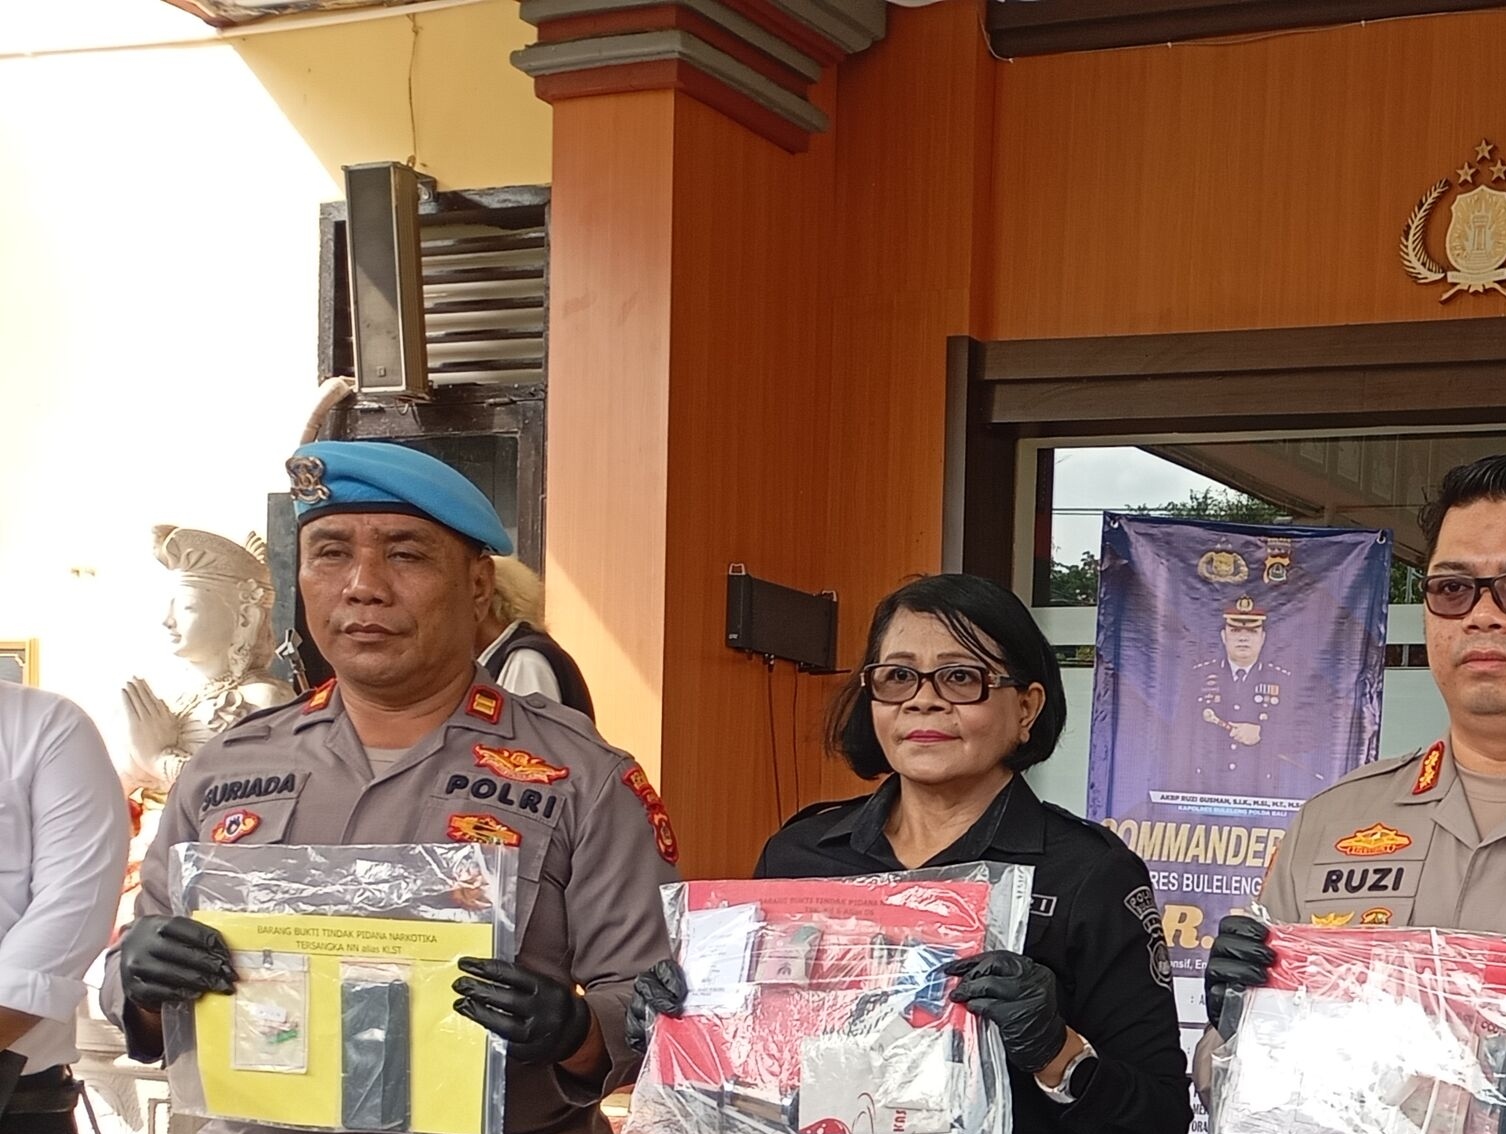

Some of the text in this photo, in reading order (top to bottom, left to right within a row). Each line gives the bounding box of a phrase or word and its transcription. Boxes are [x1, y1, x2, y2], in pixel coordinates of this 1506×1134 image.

[202, 773, 296, 811] SURIADA
[445, 774, 557, 819] POLRI
[1183, 874, 1263, 895] BULELENG
[1322, 867, 1404, 893] RUZI
[257, 925, 437, 943] BARANG BUKTI TINDAK PIDANA NARKOTIKA
[296, 940, 344, 952] TERSANGKA
